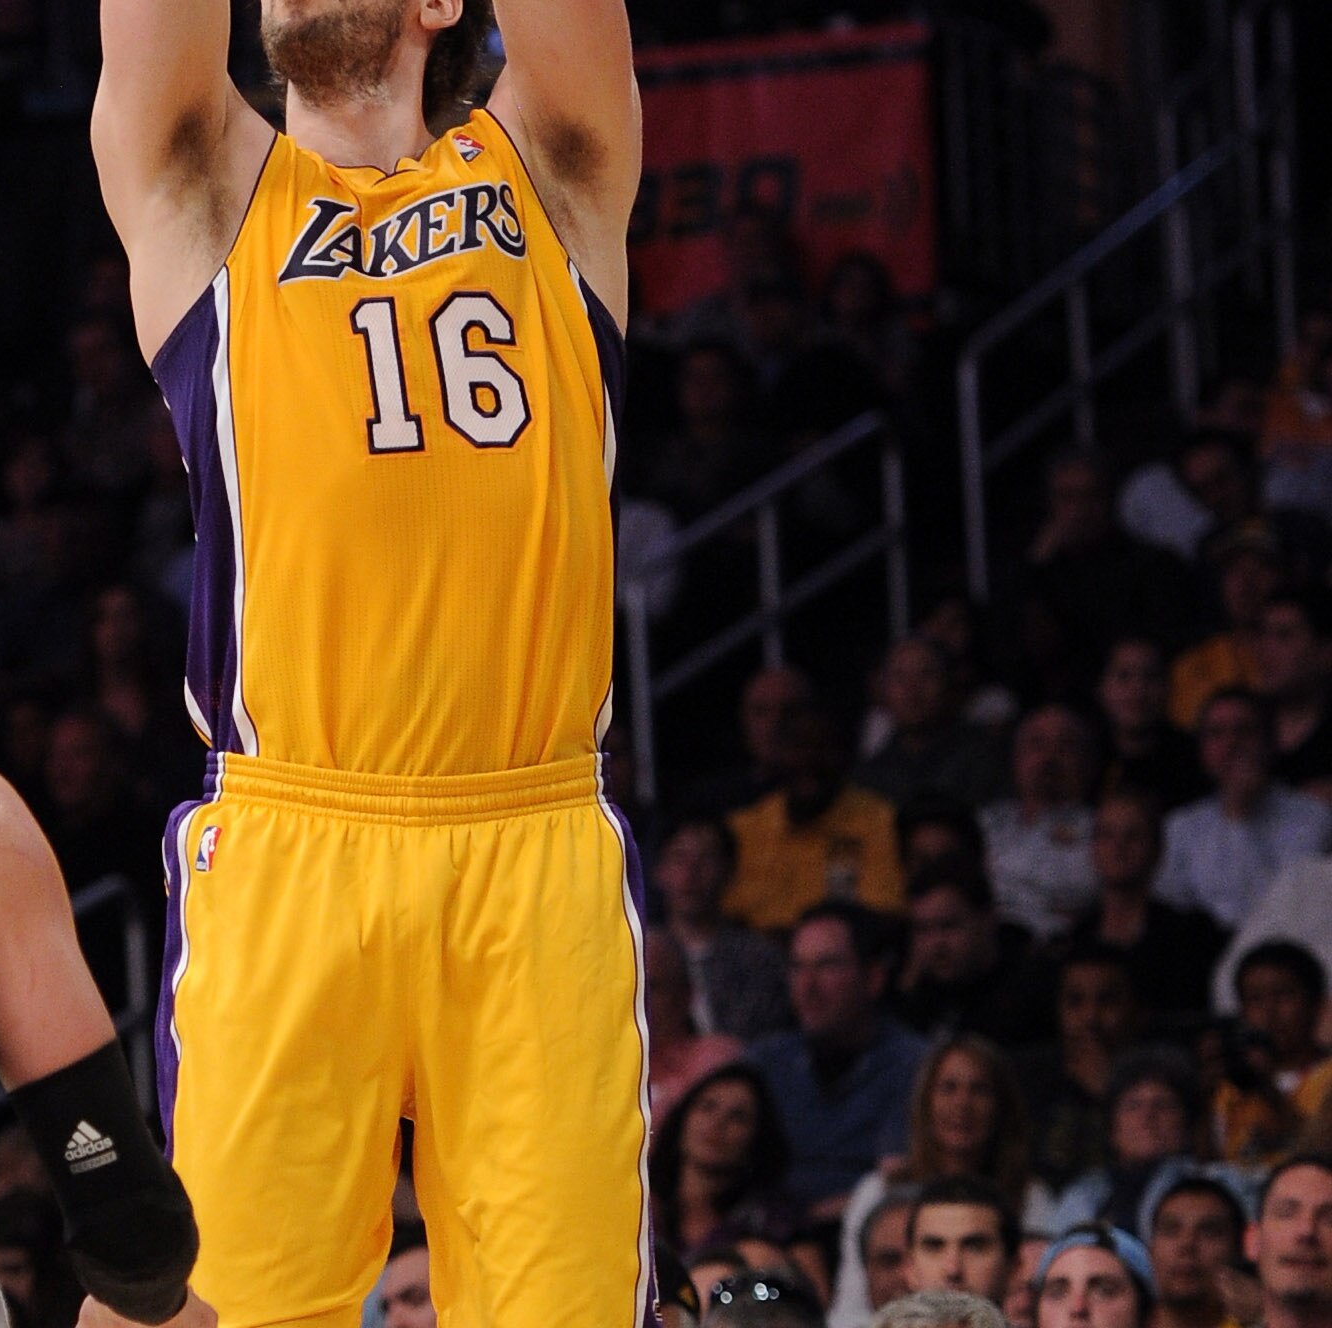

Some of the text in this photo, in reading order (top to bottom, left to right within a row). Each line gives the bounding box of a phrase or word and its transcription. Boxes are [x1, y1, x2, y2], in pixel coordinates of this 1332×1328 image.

[277, 179, 527, 284] LAKERS
[349, 290, 532, 455] 16
[64, 1137, 114, 1161] adidas
